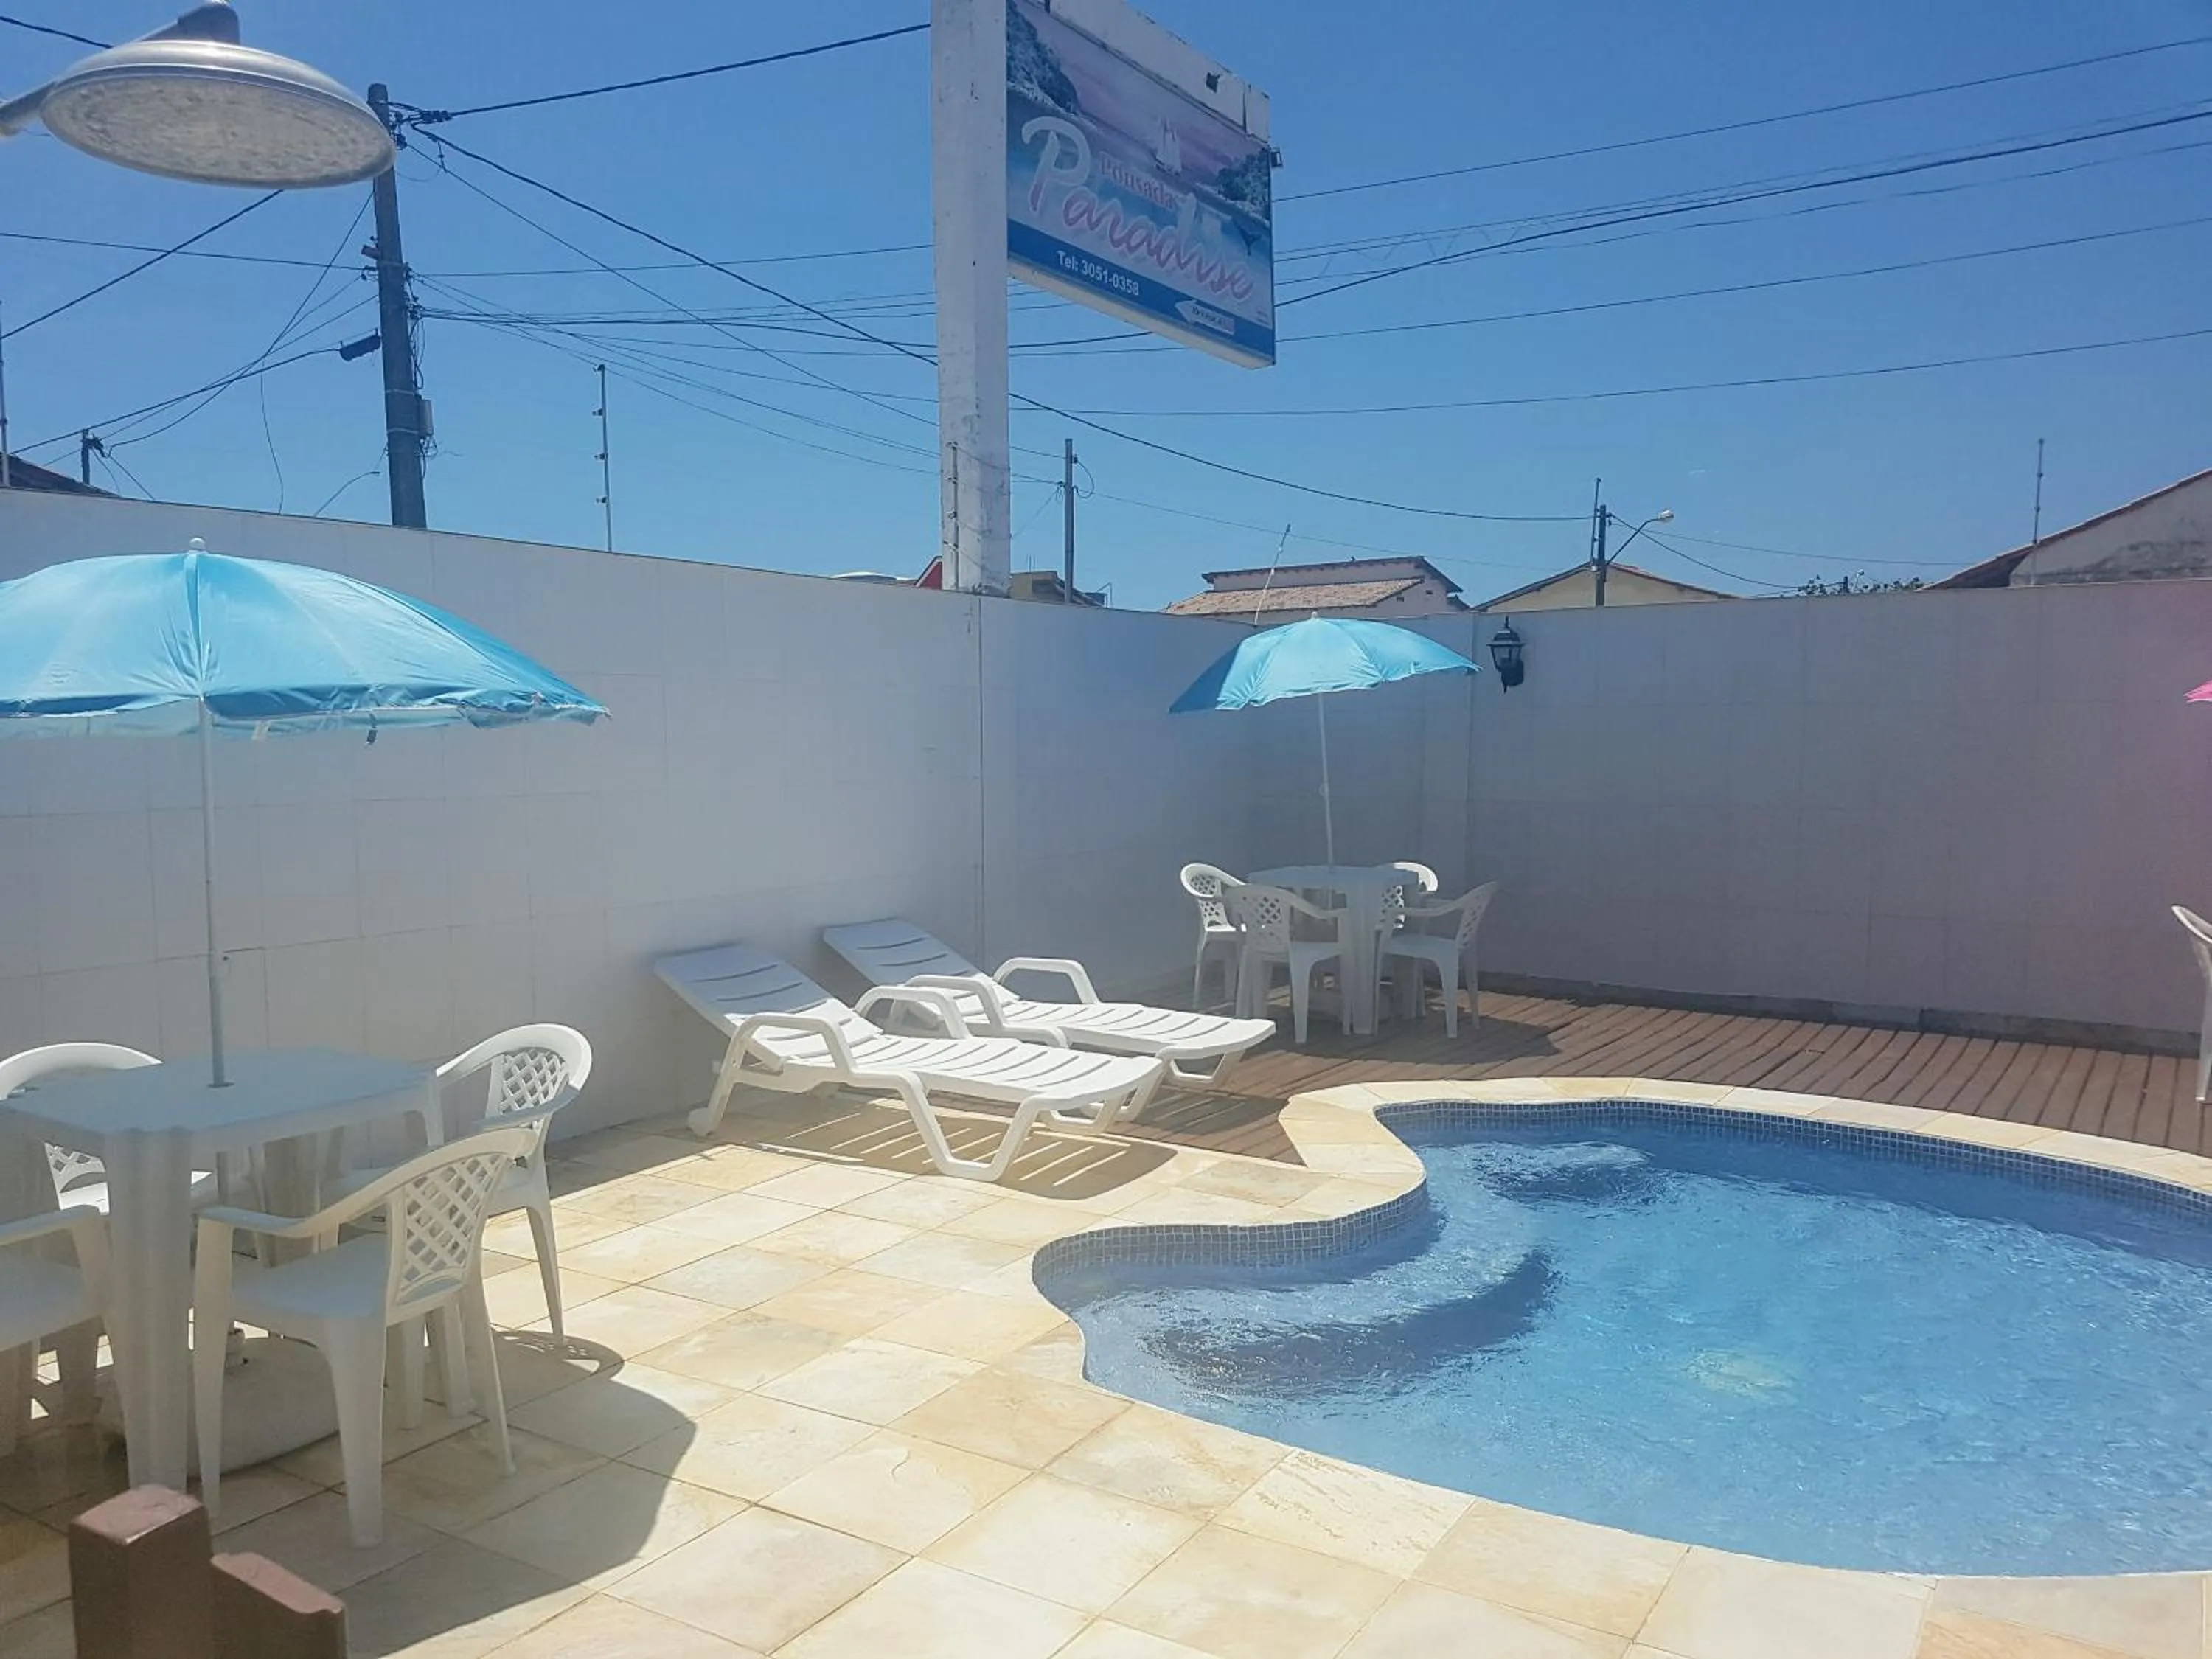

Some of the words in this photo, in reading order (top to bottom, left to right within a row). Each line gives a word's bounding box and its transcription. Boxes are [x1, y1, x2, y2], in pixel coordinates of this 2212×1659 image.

[1022, 116, 1253, 300] Paradise
[1099, 151, 1175, 210] Pousada
[1057, 250, 1079, 272] Tel:
[1081, 259, 1139, 296] 3051-0358
